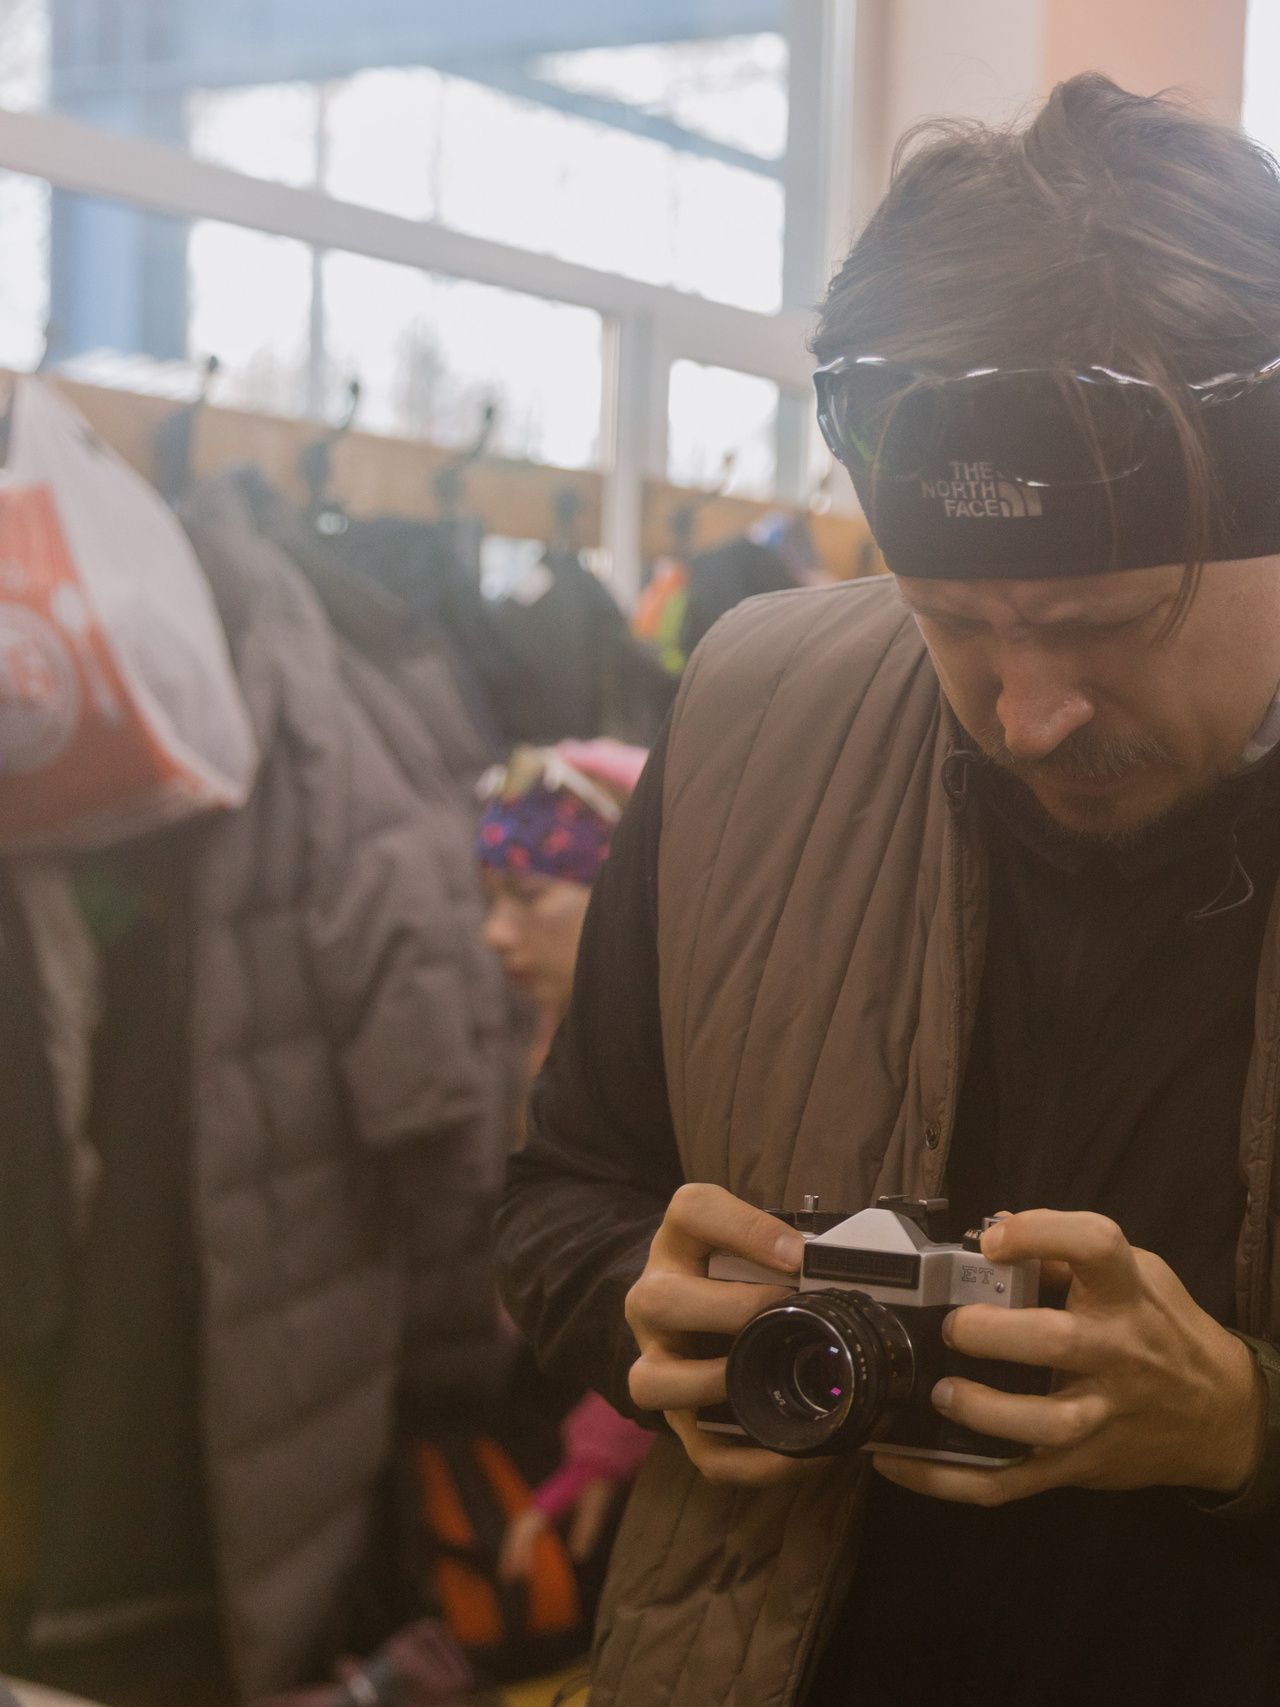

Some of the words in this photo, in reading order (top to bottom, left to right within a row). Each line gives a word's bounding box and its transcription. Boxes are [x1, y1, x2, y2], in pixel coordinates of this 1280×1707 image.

[950, 461, 994, 481] THE
[920, 480, 997, 499] NORTH
[944, 499, 1000, 518] FACE
